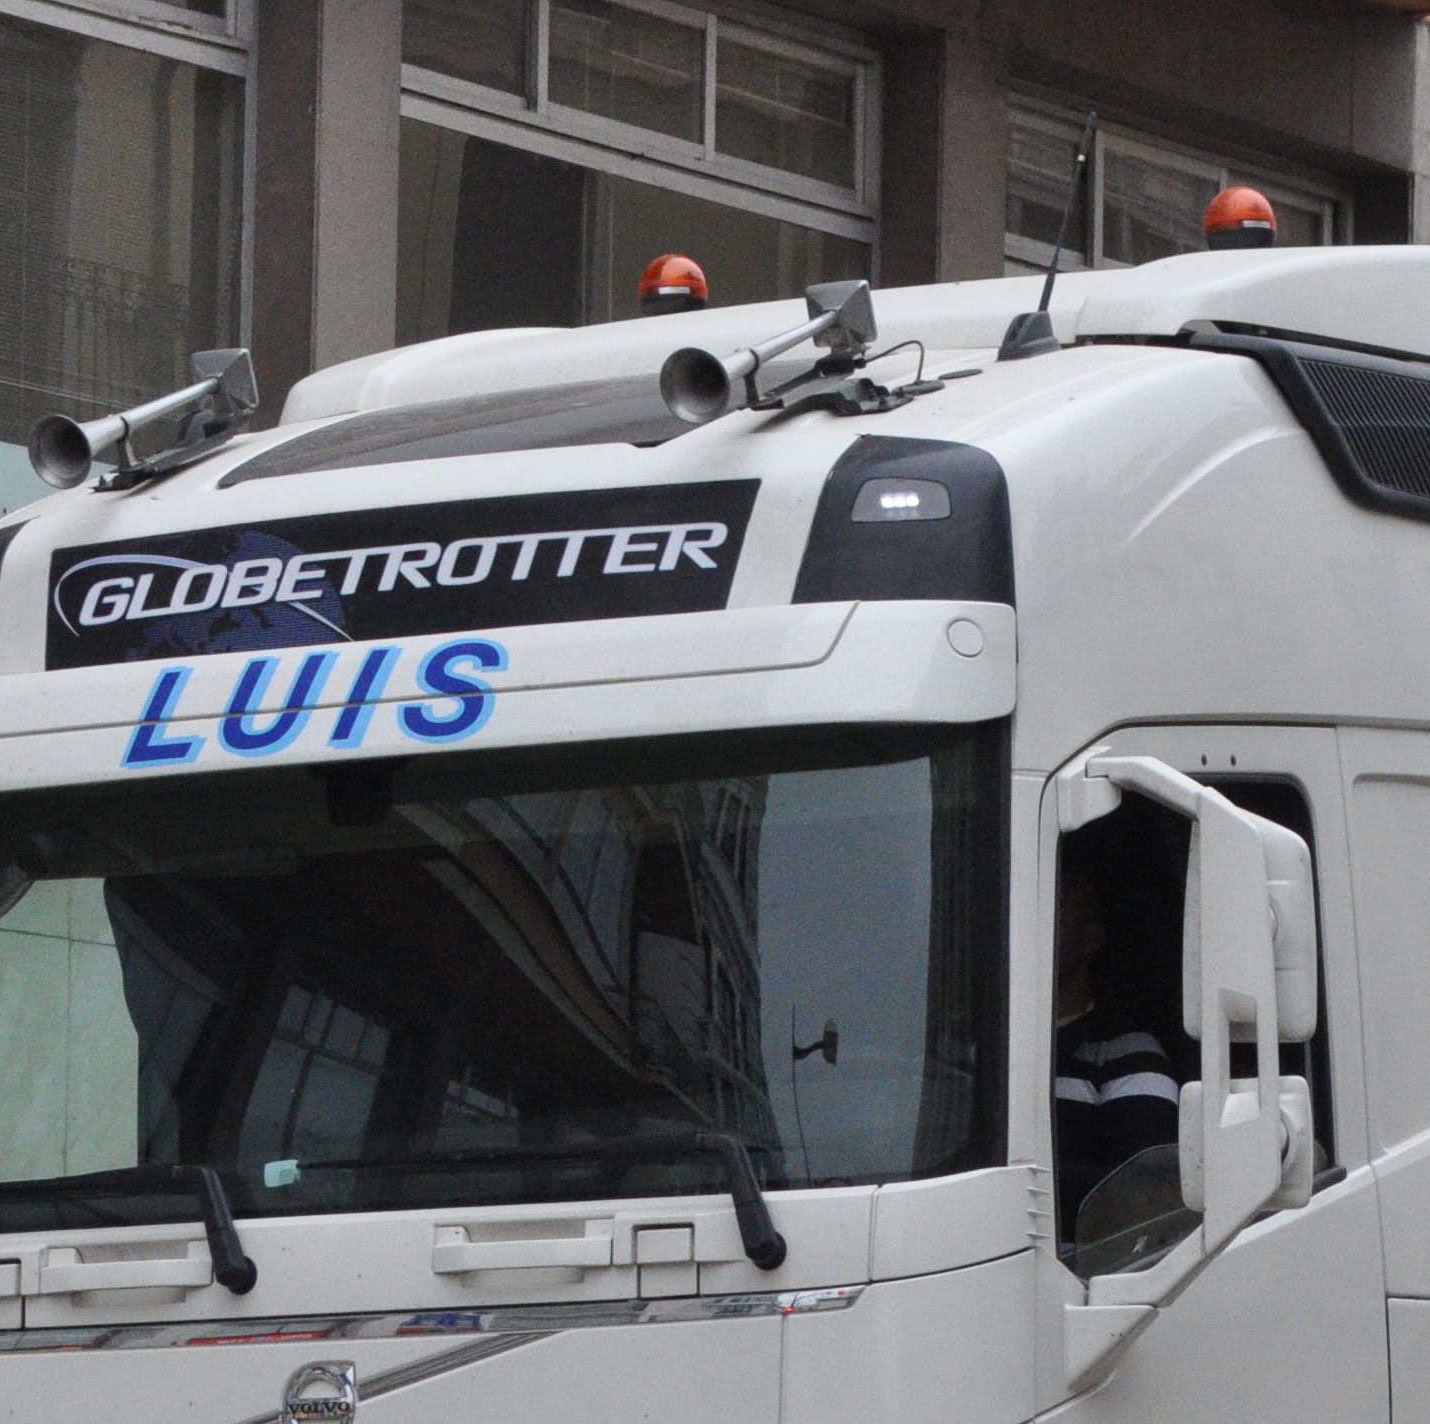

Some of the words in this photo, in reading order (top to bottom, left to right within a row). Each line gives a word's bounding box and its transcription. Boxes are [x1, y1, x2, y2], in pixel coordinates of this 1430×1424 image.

[78, 521, 728, 627] GLOBETROTTER
[120, 637, 509, 769] LUIS
[287, 1400, 351, 1416] VOLVO
